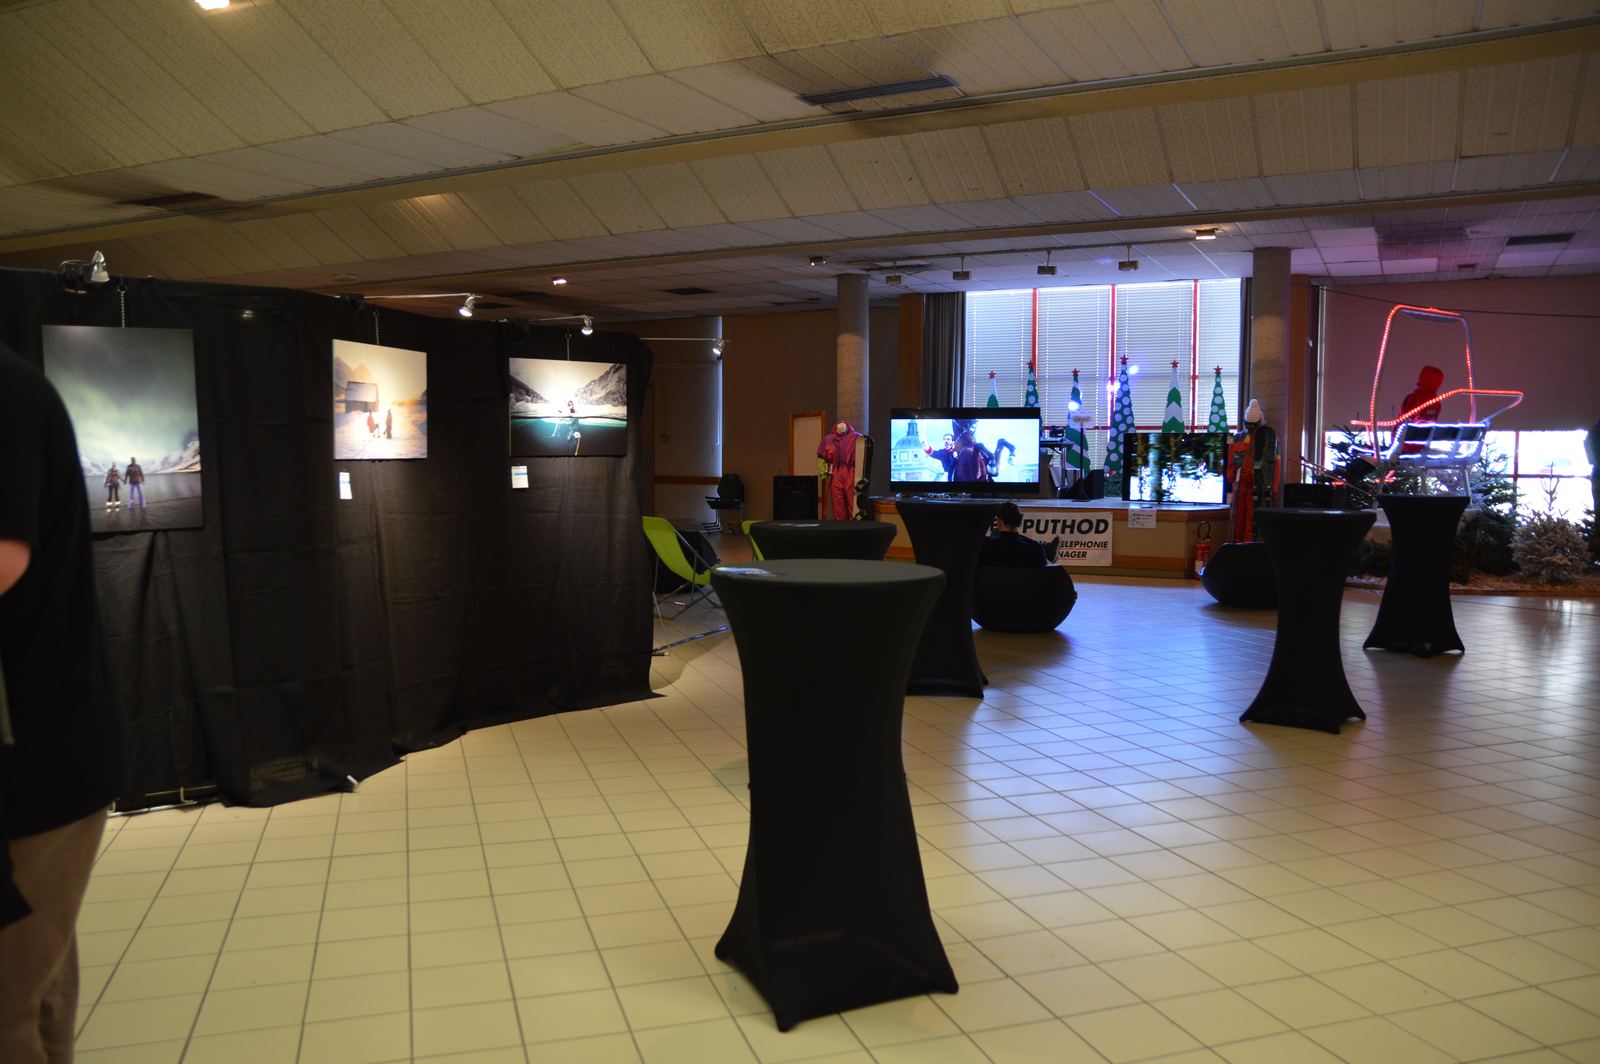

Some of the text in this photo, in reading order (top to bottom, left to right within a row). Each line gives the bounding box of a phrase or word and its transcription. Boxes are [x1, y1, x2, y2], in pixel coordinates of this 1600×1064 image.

[1023, 519, 1109, 535] PUTHOD
[1059, 541, 1108, 549] ELEPHONIE
[1058, 551, 1087, 559] NAGER
